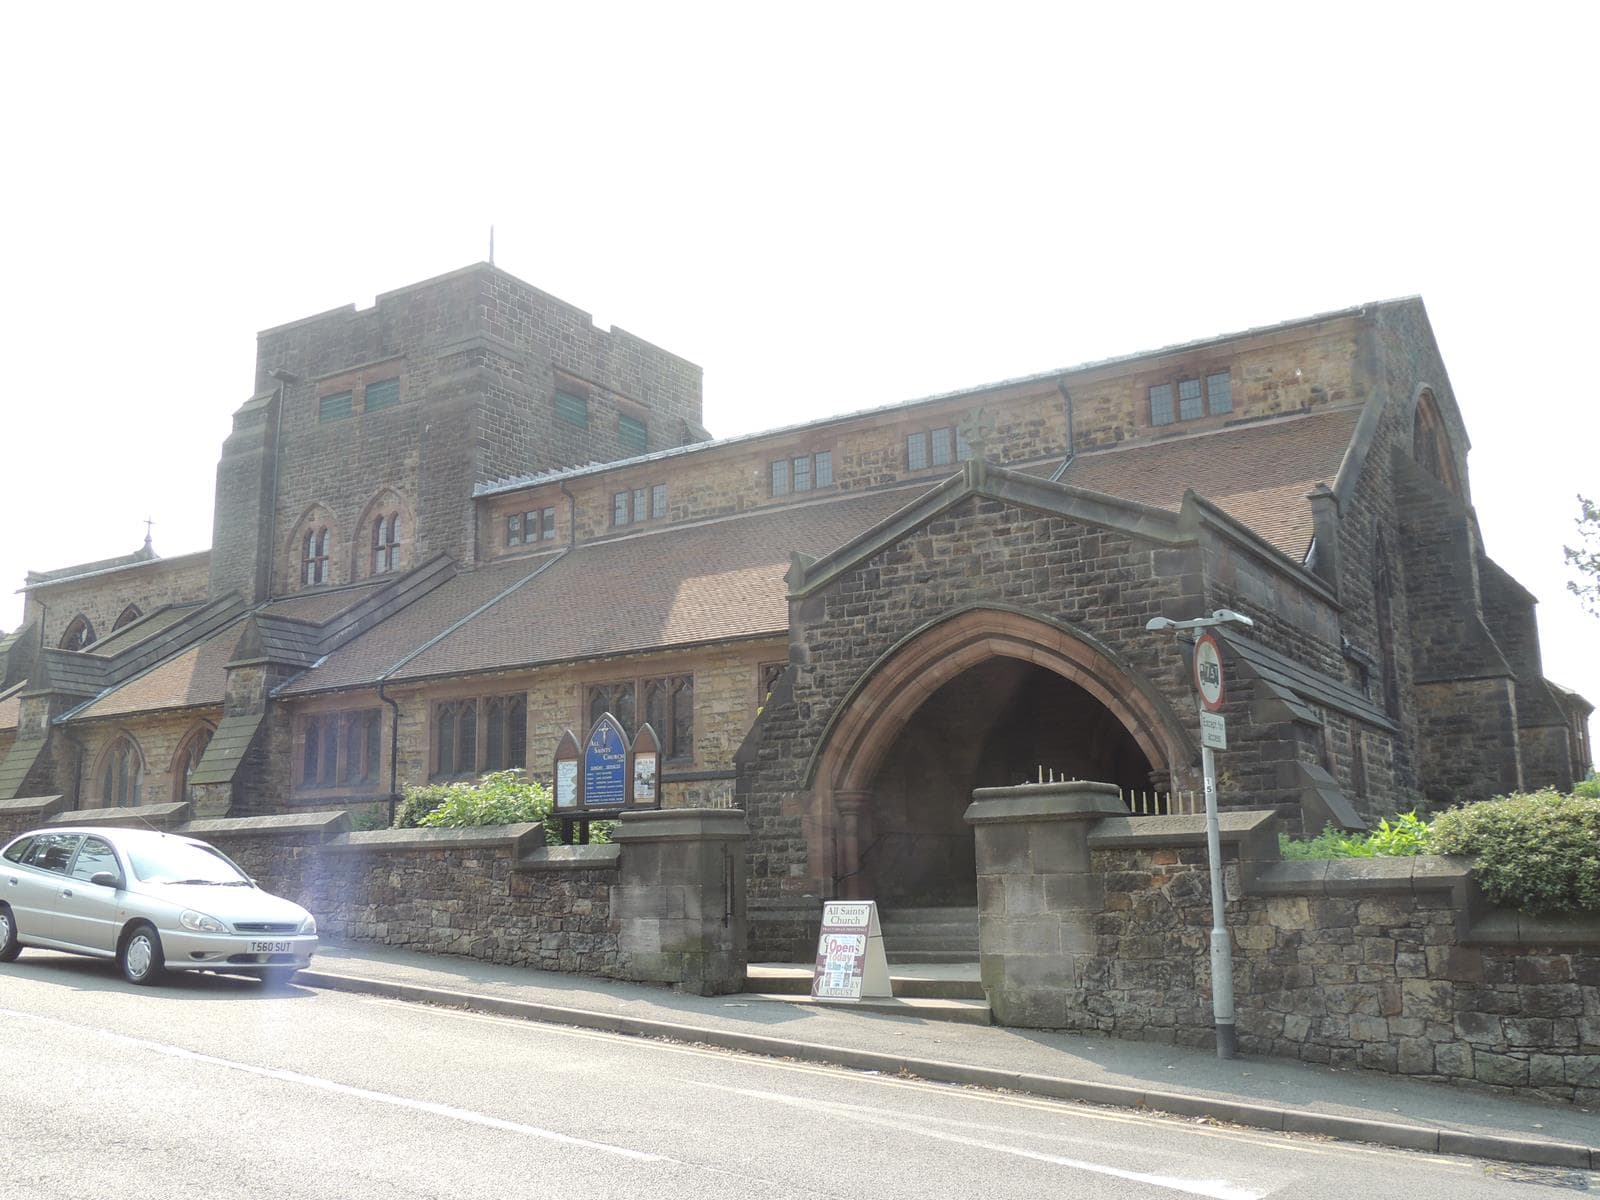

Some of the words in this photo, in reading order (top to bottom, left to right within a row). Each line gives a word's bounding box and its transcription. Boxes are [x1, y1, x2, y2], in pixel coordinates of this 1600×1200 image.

[1203, 716, 1216, 729] Except
[1207, 732, 1222, 742] access
[827, 906, 839, 915] All
[831, 916, 860, 925] Church
[251, 942, 274, 952] T560
[275, 942, 291, 952] SUT
[829, 939, 855, 954] Open
[829, 952, 852, 963] Today
[826, 988, 854, 996] AUGUST
